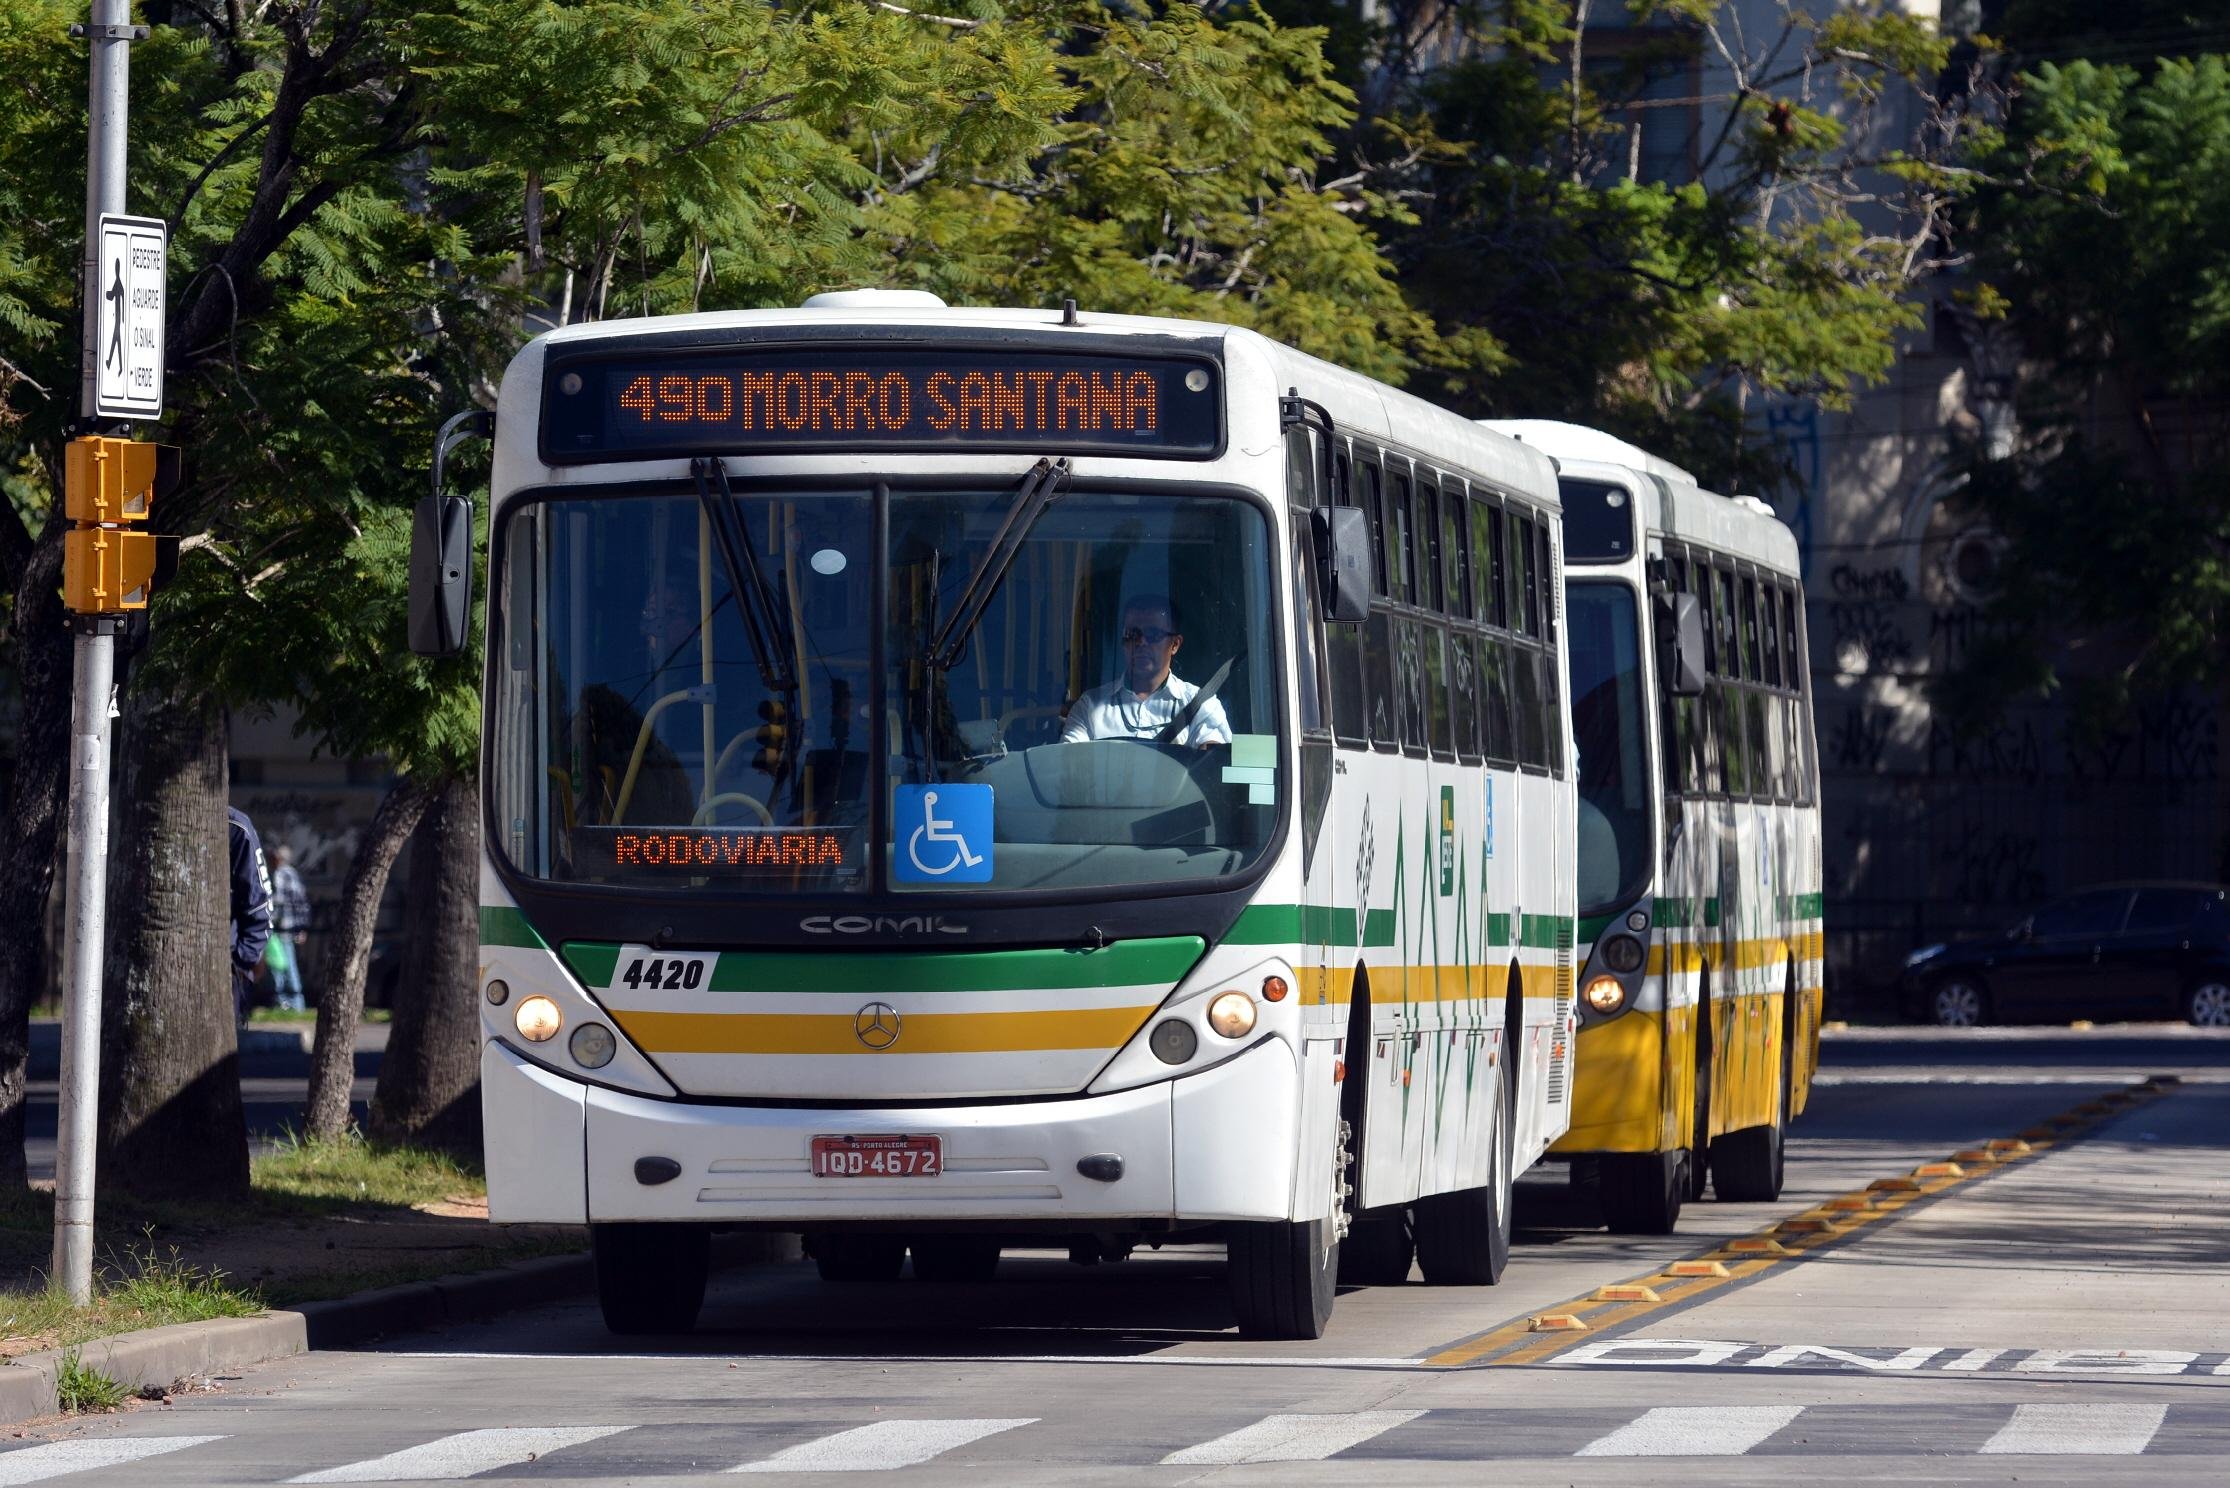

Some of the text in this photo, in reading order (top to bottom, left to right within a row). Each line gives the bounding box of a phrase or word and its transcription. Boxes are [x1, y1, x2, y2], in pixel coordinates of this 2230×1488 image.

[132, 248, 160, 270] PEDESTRE
[132, 288, 159, 309] AGUARDE
[134, 327, 154, 348] O SINAL
[135, 366, 153, 387] VERDE
[619, 371, 1158, 430] 490 MORRO SANTANA
[615, 835, 842, 864] RODOVIARIA
[799, 916, 968, 933] COMIL
[622, 959, 705, 990] 4420
